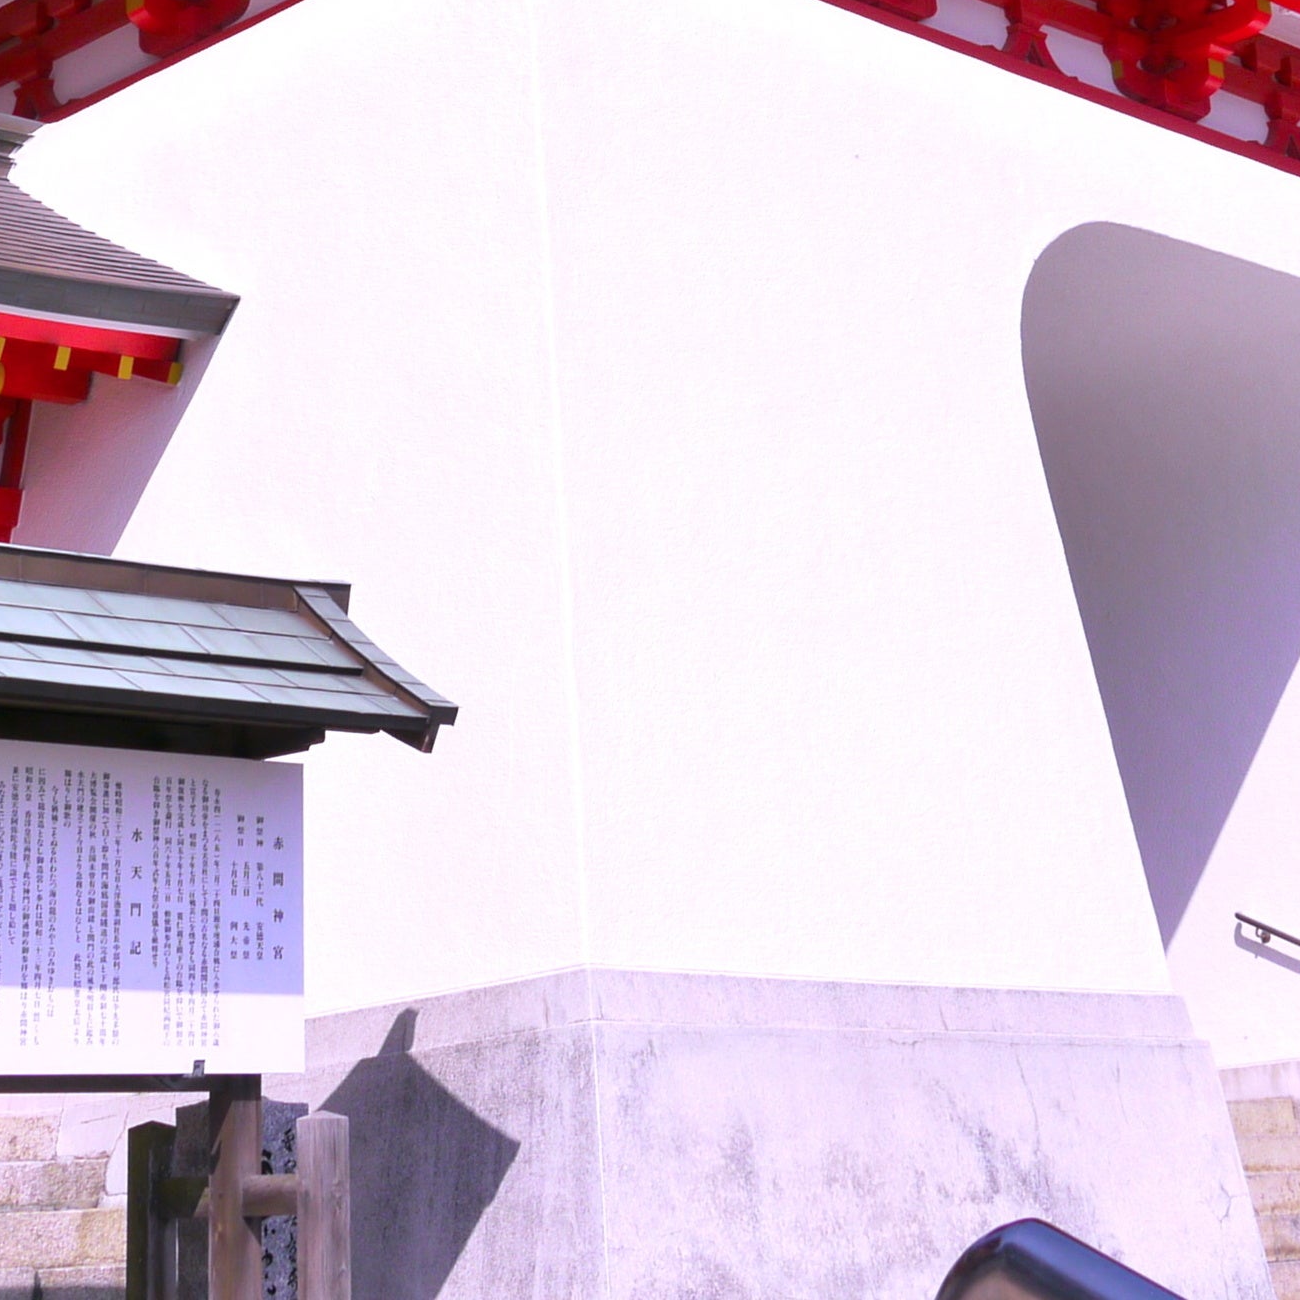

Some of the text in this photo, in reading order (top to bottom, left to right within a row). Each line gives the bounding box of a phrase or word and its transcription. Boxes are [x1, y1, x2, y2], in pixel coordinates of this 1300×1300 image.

[130, 828, 143, 956] 水天門記
[273, 836, 284, 960] 赤間神宮
